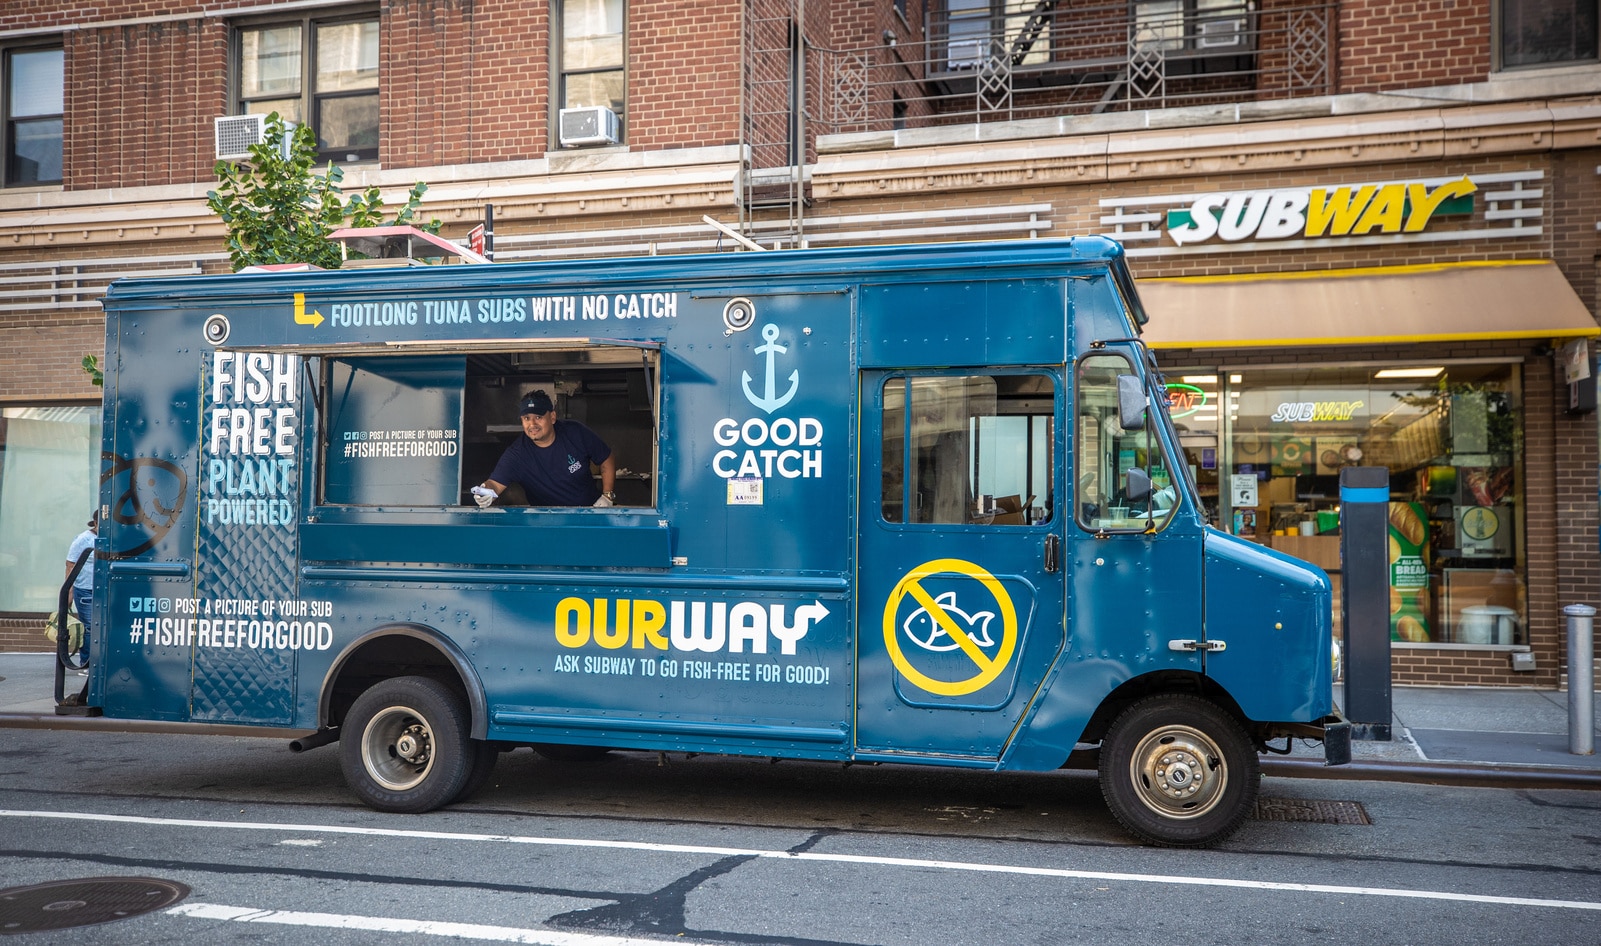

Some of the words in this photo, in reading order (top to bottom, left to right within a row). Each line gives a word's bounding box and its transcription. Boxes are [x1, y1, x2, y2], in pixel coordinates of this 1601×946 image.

[1167, 173, 1478, 247] SUBWAY
[331, 302, 417, 328] FOOTLONG
[423, 300, 473, 325] TUNA
[477, 298, 527, 324] SUBS
[532, 296, 575, 322] WITH
[582, 294, 609, 320] NO
[613, 292, 678, 319] CATCH
[212, 352, 297, 404] FISH
[1271, 400, 1364, 422] SUBWAY
[210, 408, 296, 455] FREE
[369, 431, 385, 440] POST
[386, 430, 390, 440] A
[391, 430, 416, 440] PICTURE
[417, 430, 426, 439] OF
[427, 430, 443, 440] YOUR
[444, 430, 457, 438] SUB
[713, 417, 824, 447] GOOD
[344, 440, 458, 458] #FISHFREEFORGOOD
[712, 449, 823, 479] CATCH
[209, 458, 294, 495] PLANT
[208, 499, 293, 526] POWERED
[1396, 565, 1426, 575] BREAD
[175, 598, 201, 614] POST
[204, 598, 211, 614] A
[215, 599, 258, 616] PICTURE
[262, 600, 275, 616] OF
[278, 600, 307, 617] YOUR
[311, 601, 332, 617] SUB
[130, 617, 333, 650] #FISHFREEFORGOOD
[554, 654, 580, 672] ASK
[584, 656, 635, 675] SUBWAY
[640, 659, 656, 677] TO
[660, 660, 678, 678] GO
[683, 660, 750, 681] FISH-FREE
[756, 663, 781, 682] FOR
[786, 666, 830, 685] GOOD!
